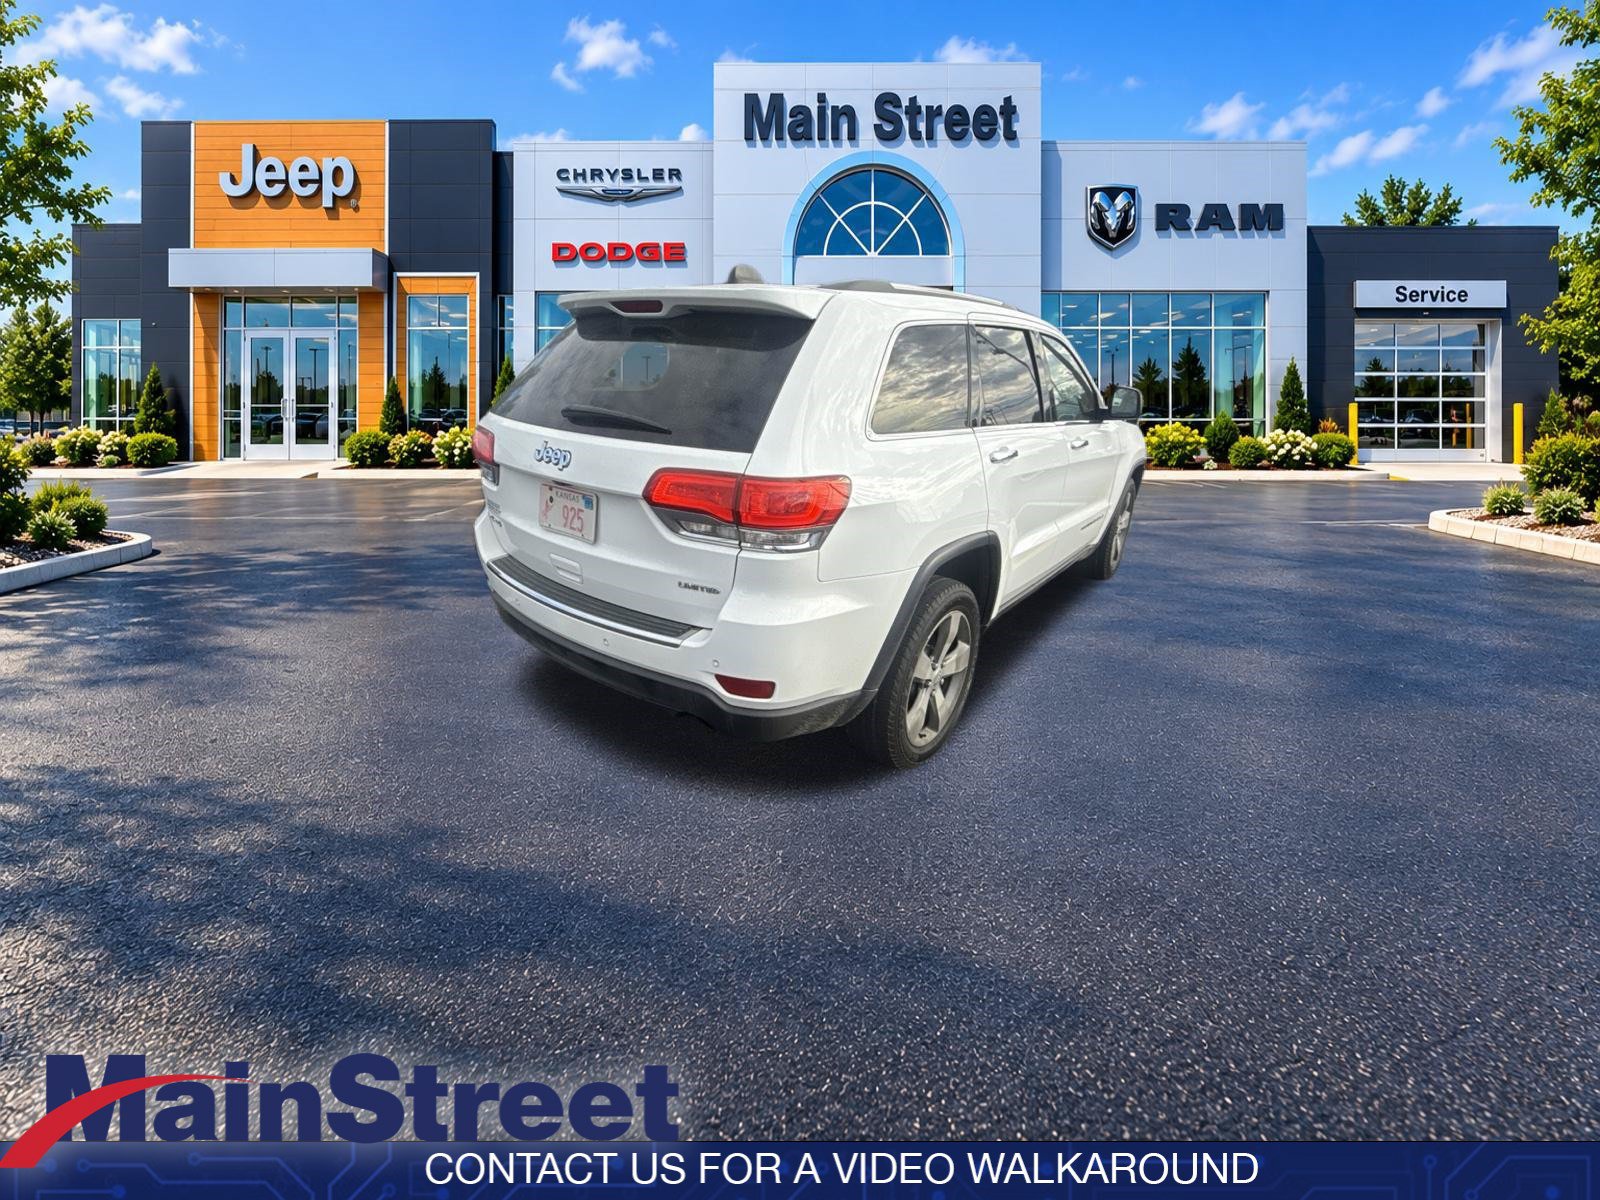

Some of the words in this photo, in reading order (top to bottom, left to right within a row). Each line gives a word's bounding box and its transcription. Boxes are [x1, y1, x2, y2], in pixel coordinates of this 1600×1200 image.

[743, 92, 856, 142] Main
[874, 91, 1019, 142] Street
[219, 144, 355, 208] Jeep
[556, 168, 682, 184] CHRYSLER
[1155, 203, 1283, 231] RAM
[551, 242, 687, 262] DODGE
[1395, 285, 1468, 305] Service
[534, 440, 572, 471] Jeep
[562, 504, 584, 533] 925
